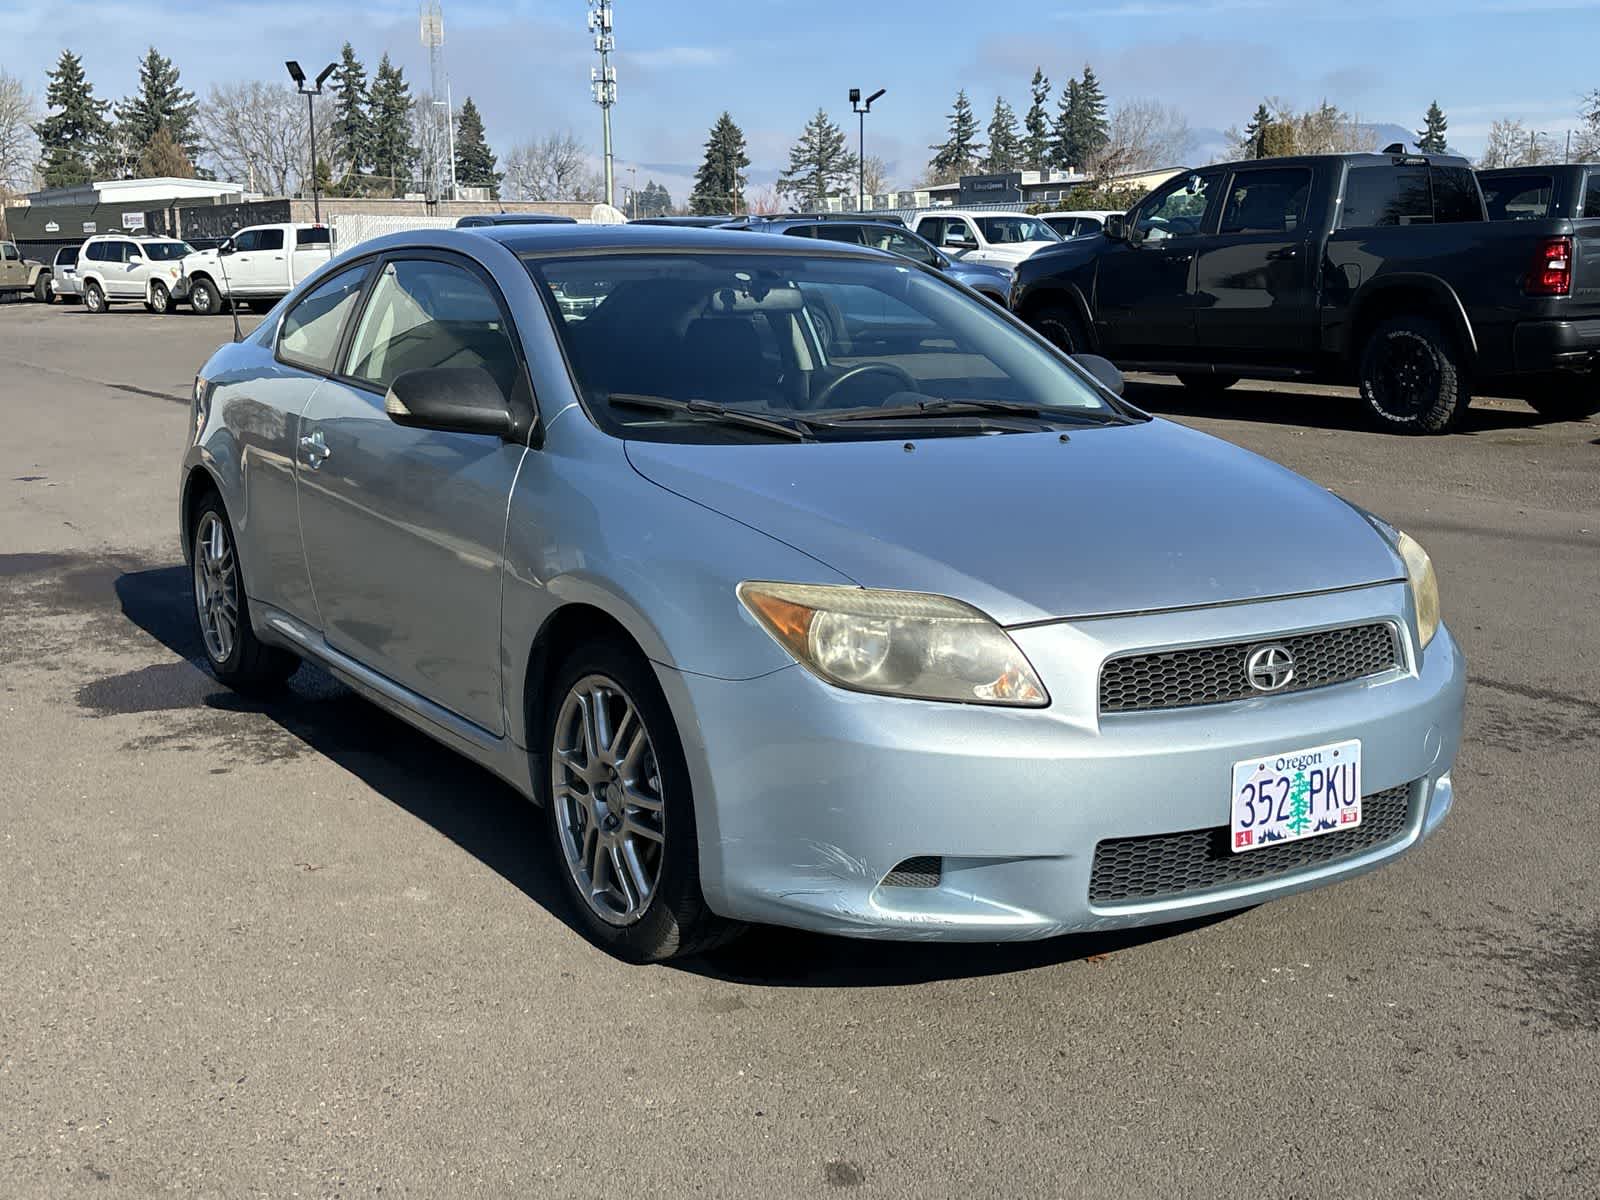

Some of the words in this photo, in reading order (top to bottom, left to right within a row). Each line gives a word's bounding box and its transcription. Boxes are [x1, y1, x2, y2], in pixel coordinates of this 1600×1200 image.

[1276, 753, 1322, 771] Oregon
[1241, 777, 1290, 828] 352
[1309, 762, 1356, 815] PKU
[1240, 832, 1248, 845] 1
